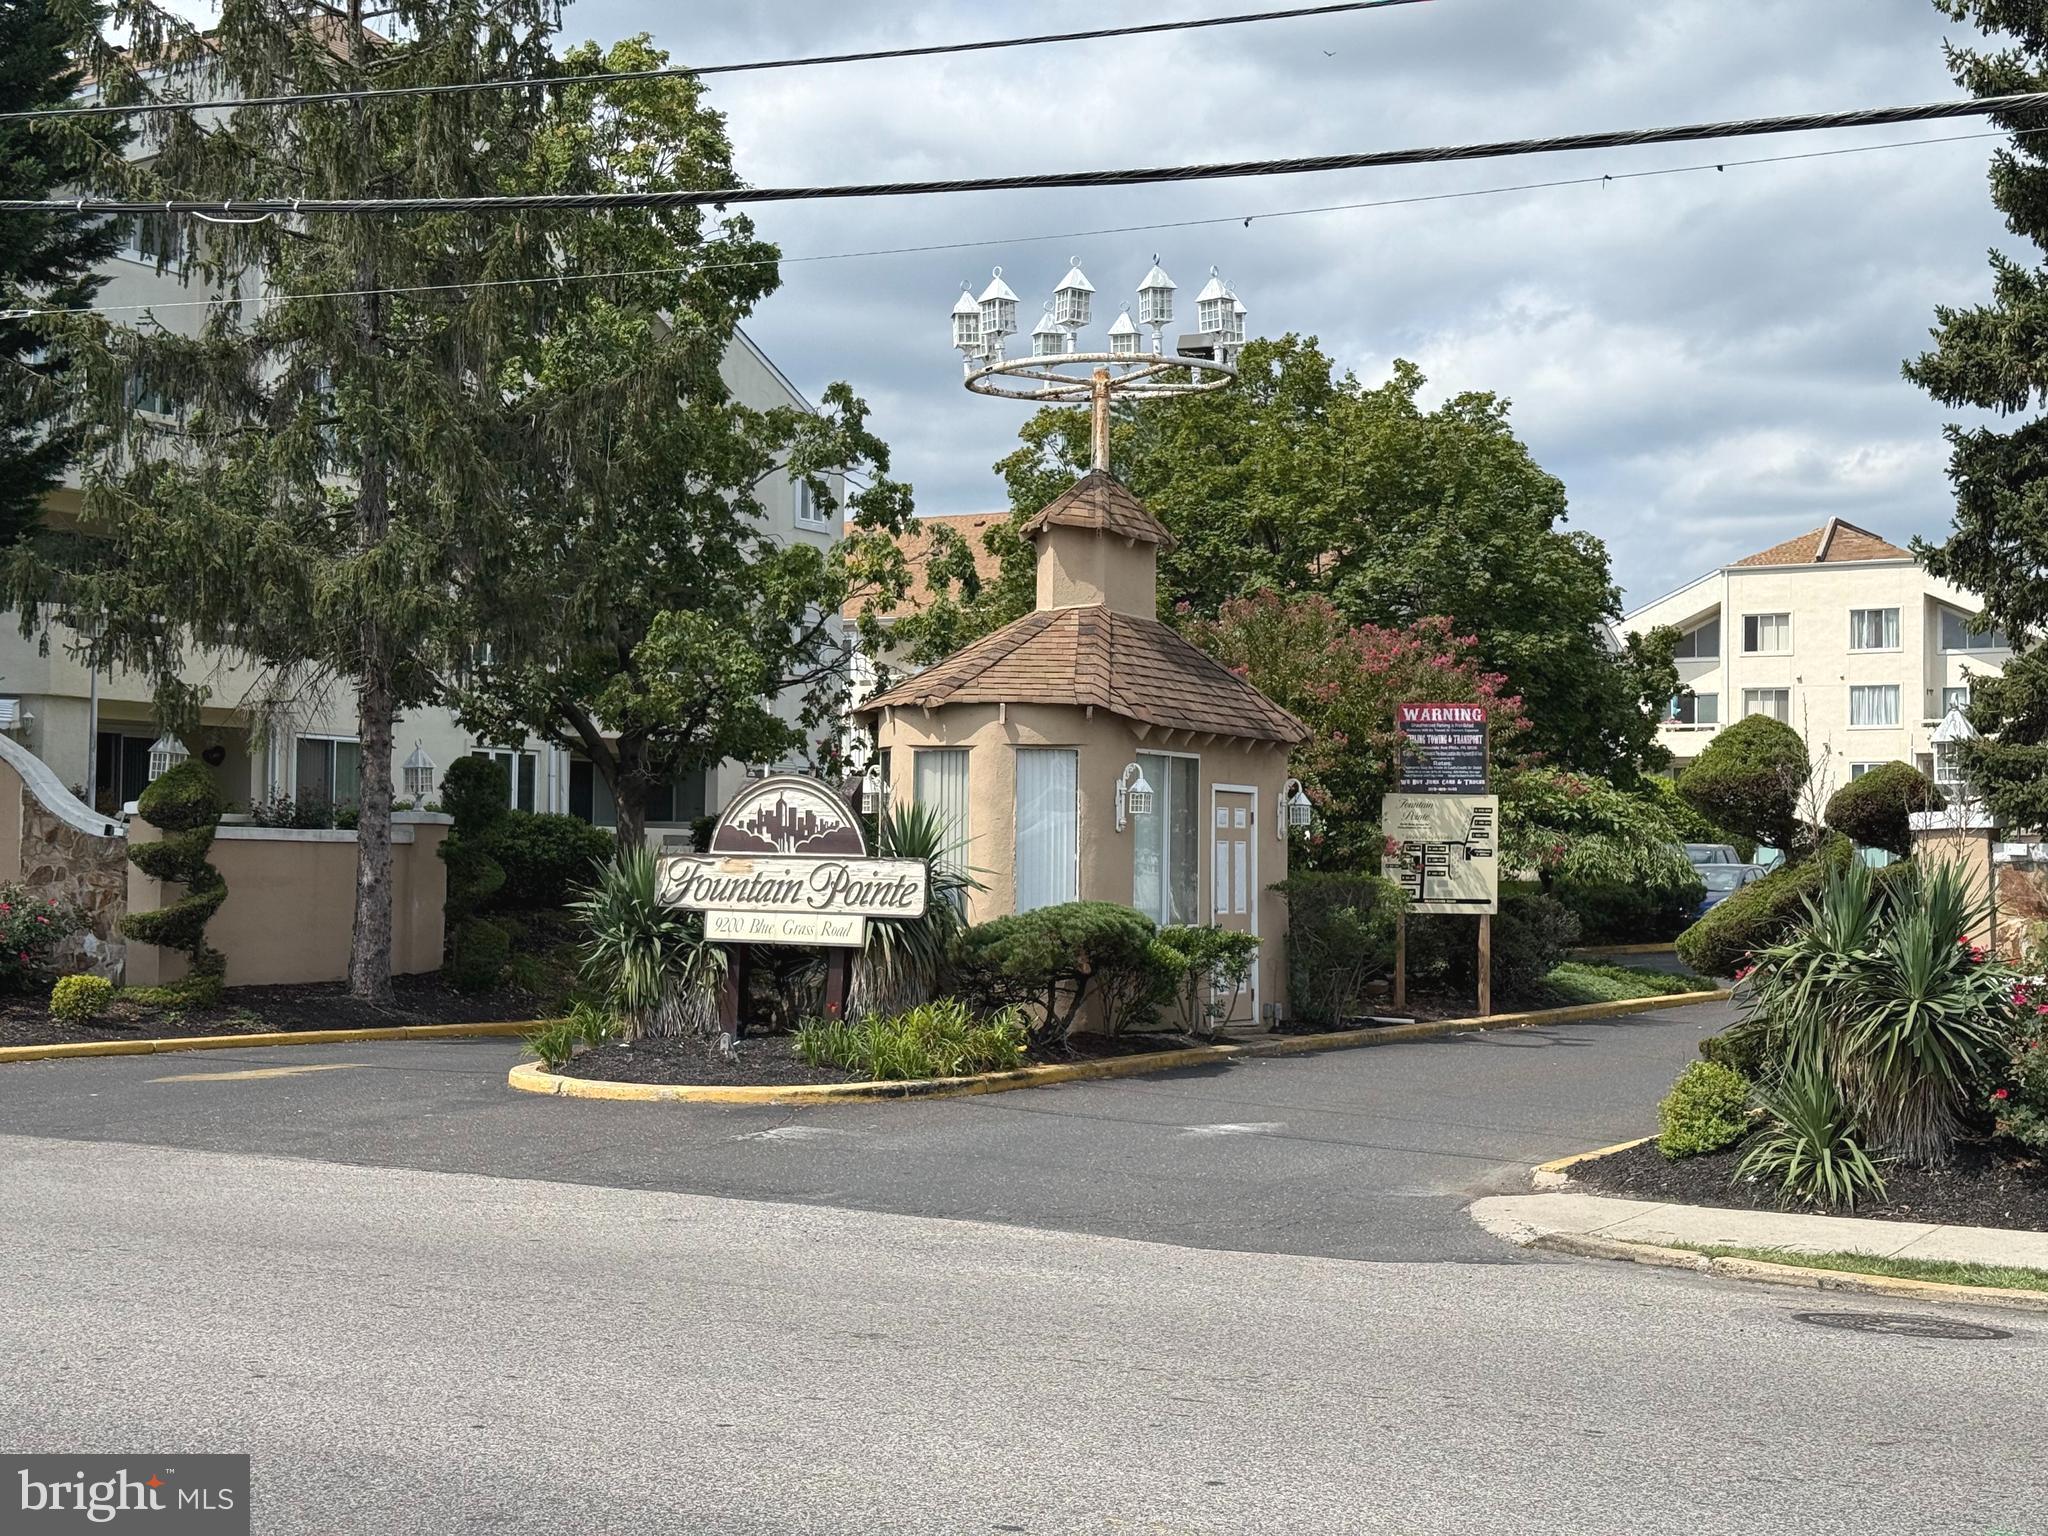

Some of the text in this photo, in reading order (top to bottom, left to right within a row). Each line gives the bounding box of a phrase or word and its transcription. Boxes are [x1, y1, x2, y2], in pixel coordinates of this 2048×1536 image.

[1403, 708, 1483, 721] WARNING
[1427, 734, 1448, 744] TOWING
[1453, 734, 1483, 744] TRANSPORT
[1399, 799, 1434, 809] Fountain
[658, 857, 919, 909] Fountain Pointe
[715, 917, 853, 937] 9200 Blue Grass Road
